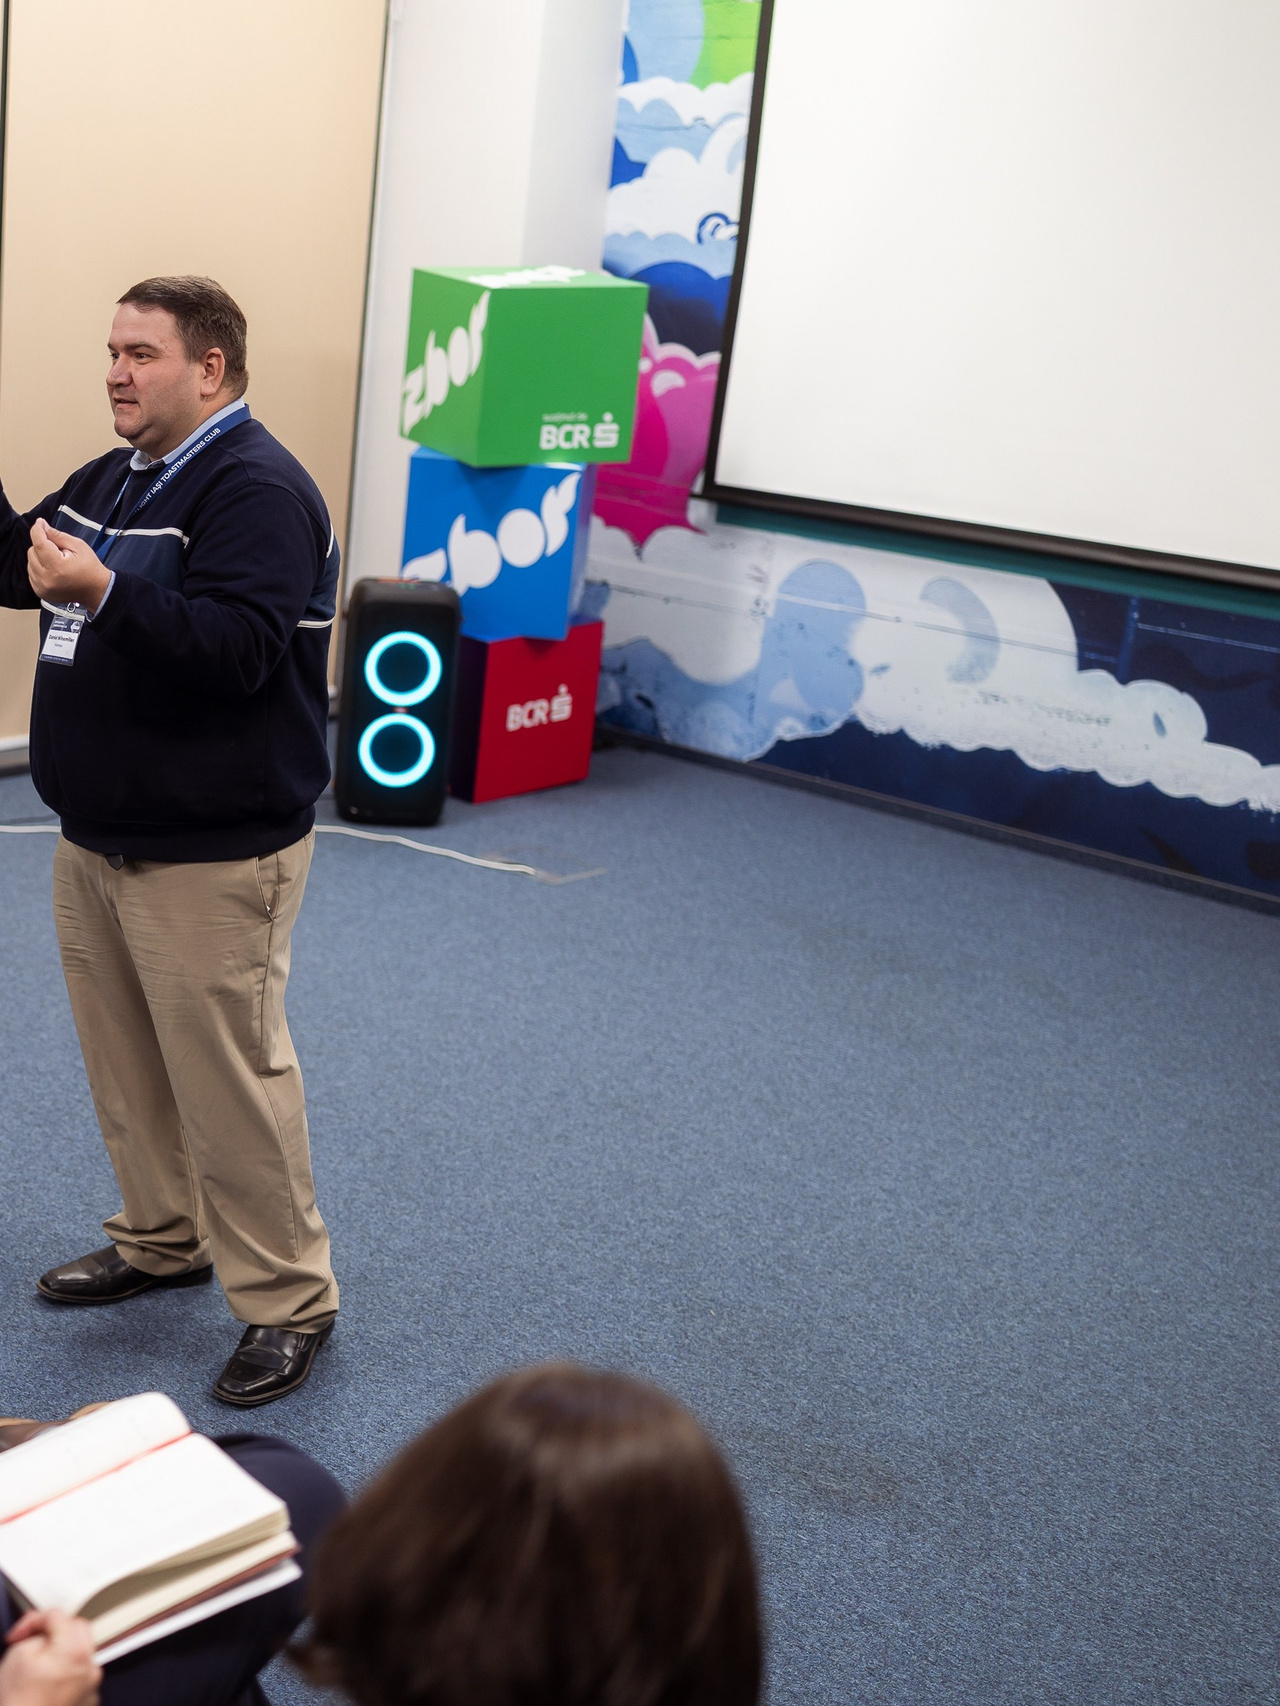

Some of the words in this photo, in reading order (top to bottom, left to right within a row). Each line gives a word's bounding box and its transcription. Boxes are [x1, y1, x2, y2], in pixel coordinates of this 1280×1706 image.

[540, 424, 591, 450] BCR
[160, 440, 206, 483] TOASTMASTERS
[204, 427, 221, 442] CLUB
[506, 698, 549, 732] BCR
